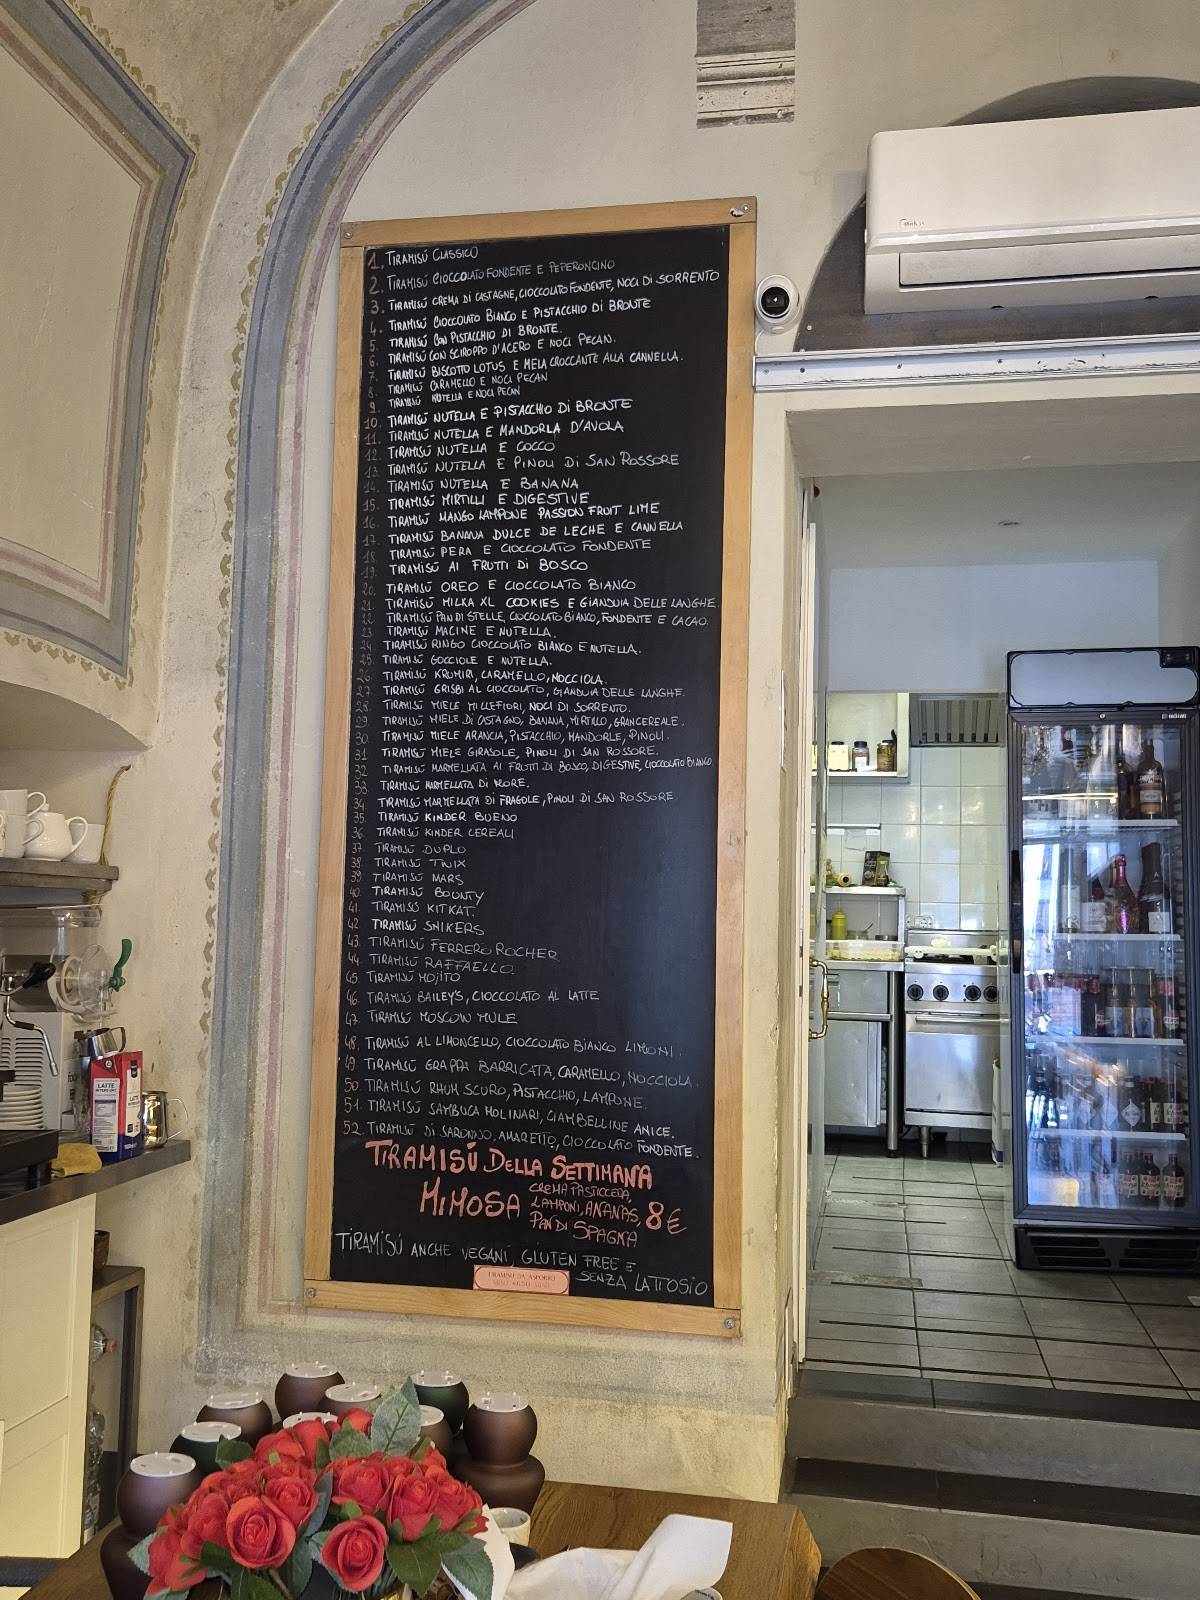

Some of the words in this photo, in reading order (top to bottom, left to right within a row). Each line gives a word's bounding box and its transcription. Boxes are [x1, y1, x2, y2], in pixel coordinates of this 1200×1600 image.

[431, 246, 478, 261] CLASSICO
[431, 268, 484, 284] CIOCCOLATO
[485, 263, 531, 278] FONDENTE
[536, 263, 544, 274] E
[548, 258, 615, 273] PEPERONCINO
[431, 294, 459, 306] CREMA
[654, 268, 720, 284] SORRENTO
[432, 313, 481, 328] CIOCCOLATO
[520, 309, 527, 319] E
[532, 303, 587, 318] PISTACCHIO
[608, 297, 651, 312] BRONTE
[432, 332, 448, 346] CON
[449, 329, 496, 343] PISTACCHIO
[428, 349, 446, 362] CON
[448, 344, 488, 360] SCIROPPO
[536, 337, 544, 349] E
[430, 363, 470, 378] BISCOTTO
[472, 360, 506, 374] LOTUS
[512, 359, 519, 370] E
[522, 357, 547, 370] MELA
[548, 352, 599, 367] CROCCANTE
[602, 351, 624, 364] ALLA
[429, 376, 476, 391] CARAMELLO
[516, 371, 548, 383] PECAN
[432, 409, 475, 423] NUTELLA
[479, 406, 488, 419] E
[492, 402, 552, 418] PISTACCHIO
[575, 397, 633, 413] BRONTE
[433, 427, 479, 440] NUTELLA
[484, 425, 494, 438] E
[498, 421, 561, 436] MANDORLA
[436, 442, 487, 456] NUTELLA
[498, 440, 508, 453] E
[515, 440, 555, 452] COCCO
[434, 459, 486, 473] NUTELLA
[496, 456, 505, 470] E
[584, 452, 615, 467] SAN
[618, 450, 679, 466] ROSSORE
[439, 477, 488, 490] NUTELLA
[499, 477, 511, 489] E
[519, 476, 579, 490] BANANA
[440, 492, 484, 506] MIRTILLI
[497, 492, 507, 505] E
[512, 491, 590, 505] DIGESTIVE
[438, 509, 474, 523] MANGO
[478, 507, 527, 520] LAMPONE
[536, 506, 584, 519] PASSION
[587, 504, 622, 516] FRUIT
[628, 501, 660, 515] LIME
[491, 527, 531, 540] DULCE
[538, 525, 557, 536] DE
[563, 522, 605, 536] LECHE
[614, 521, 623, 533] E
[630, 520, 683, 532] CANNELLA
[440, 545, 472, 558] PERA
[482, 544, 492, 555] E
[499, 541, 576, 554] CIOCCOLATO
[580, 538, 651, 552] FONDENTE
[447, 560, 459, 572] AI
[471, 558, 509, 571] FRUTTI
[538, 557, 588, 571] BOSCO
[440, 580, 479, 593] OREO
[487, 578, 497, 590] E
[503, 577, 582, 591] CIOCCOLATO
[441, 596, 474, 607] MILKA
[479, 595, 495, 607] XL
[505, 596, 560, 608] COOKIES
[567, 597, 575, 608] E
[632, 595, 668, 608] DELLE
[600, 611, 652, 624] FONDENTE
[656, 613, 667, 624] E
[434, 624, 476, 636] MACINE
[485, 624, 495, 636] E
[430, 637, 465, 649] RINGO
[470, 638, 532, 650] CIOCCOLATO
[578, 640, 588, 652] E
[430, 654, 478, 665] GOCCIOLE
[486, 654, 494, 665] E
[467, 683, 482, 693] AL
[600, 686, 635, 698] DELLE
[430, 700, 460, 710] MIELE
[429, 730, 460, 740] MIELE
[430, 745, 461, 758] MIELE
[524, 745, 557, 757] PINOLI
[581, 746, 599, 756] SAN
[430, 760, 487, 773] MARMELLATA
[618, 790, 674, 802] ROSSORE
[424, 810, 466, 822] KINDER
[473, 810, 517, 822] BUENO
[424, 827, 463, 837] KINDER
[467, 826, 514, 839] CEREALI
[421, 843, 466, 854] DUPLO
[431, 872, 464, 885] MARS
[433, 886, 484, 906] BOUNTY
[422, 919, 484, 936] SNIKERS
[429, 941, 492, 955] FERRERO
[494, 941, 557, 960] ROCHER
[471, 989, 540, 1002] CIOCCOLATO
[547, 989, 559, 1002] AL
[567, 989, 599, 1001] LATTE
[475, 1010, 518, 1024] MULE
[415, 1035, 431, 1048] AL
[504, 1035, 569, 1049] CIOCCOLATO
[424, 1058, 469, 1073] GRAPPA
[428, 1080, 459, 1096] RHUM
[427, 1102, 480, 1117] SAMBUCA
[482, 1147, 542, 1176] DELLA
[550, 1154, 652, 1190] SETTIMANA
[419, 1176, 520, 1219] MIMOSA
[572, 1220, 637, 1248] SPAGNA
[410, 1242, 451, 1257] ANCHE
[520, 1248, 577, 1266] GLUTEN
[581, 1254, 620, 1271] FREE
[576, 1271, 626, 1290] SENZA
